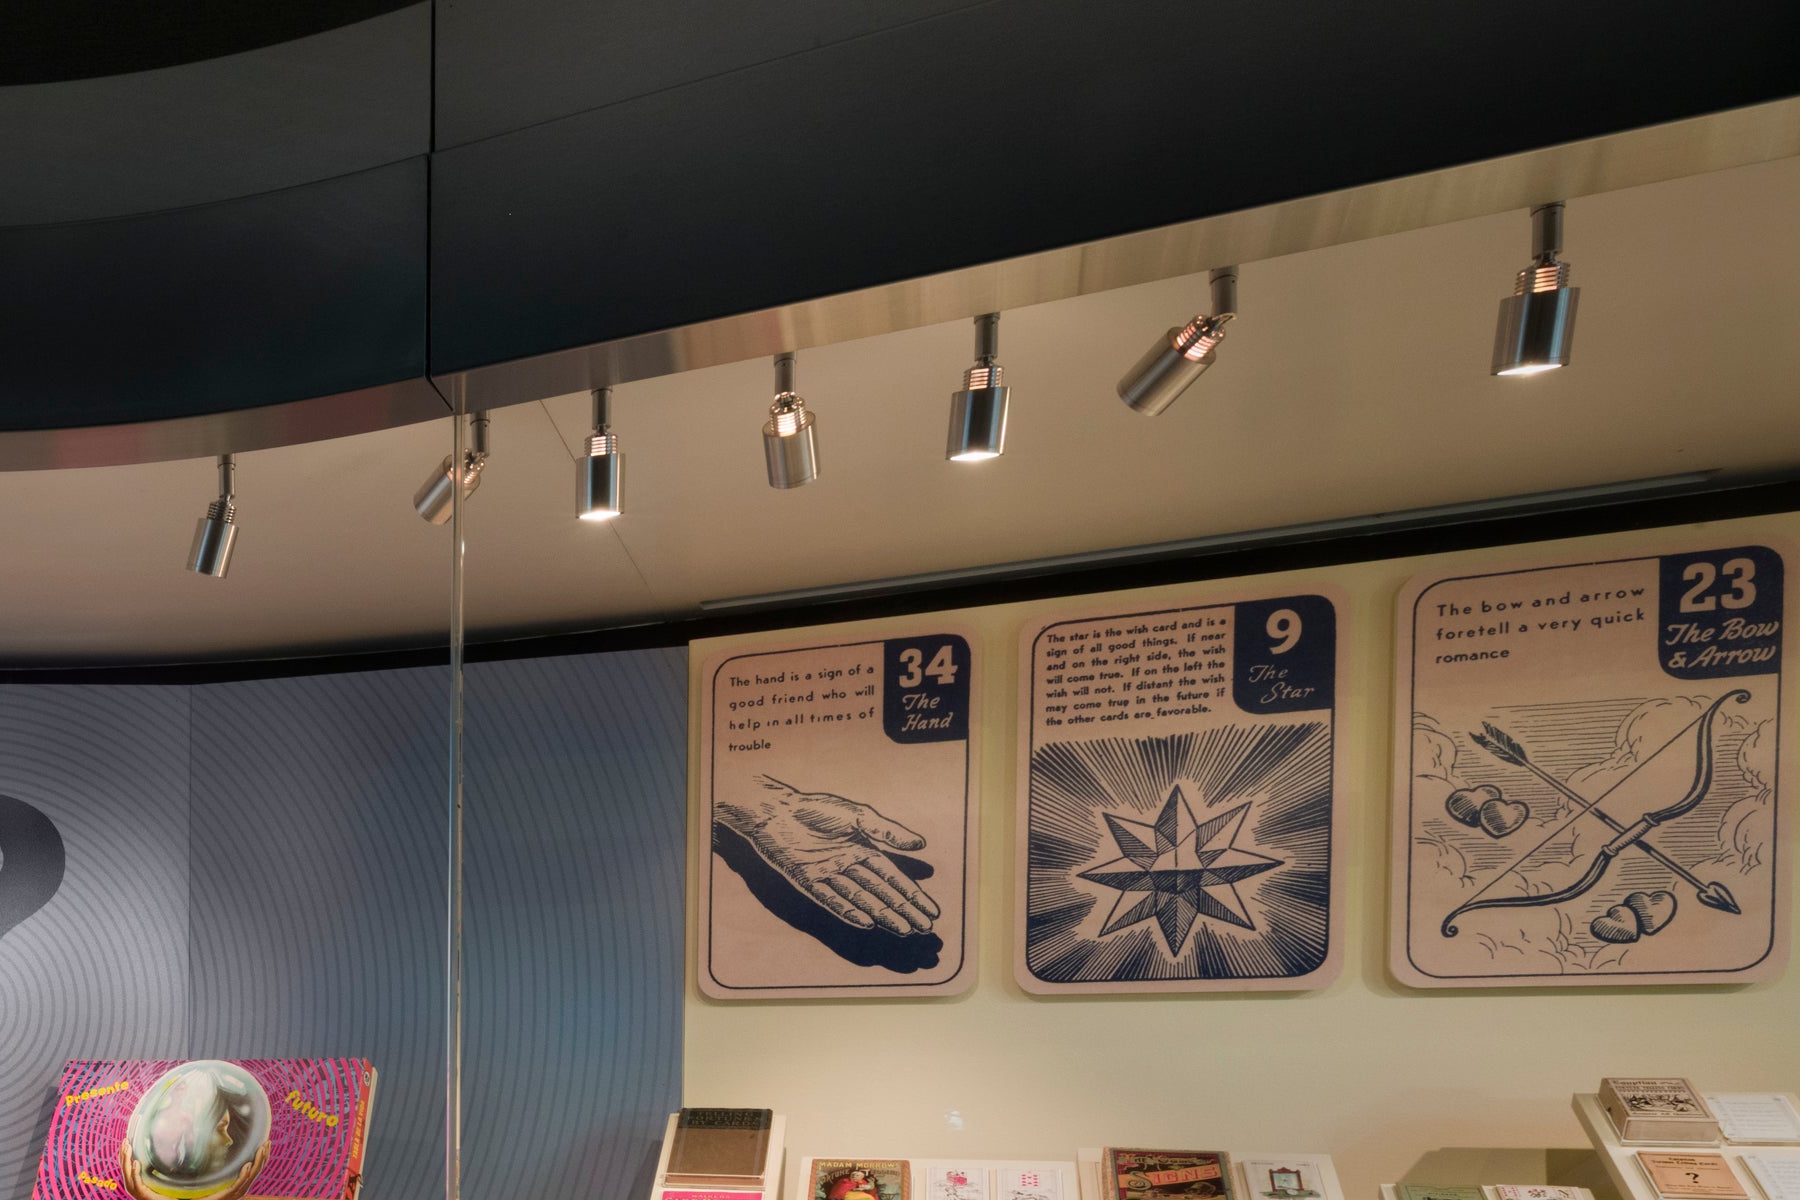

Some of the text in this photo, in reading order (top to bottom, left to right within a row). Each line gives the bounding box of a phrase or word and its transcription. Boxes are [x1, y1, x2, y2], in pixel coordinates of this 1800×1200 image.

[1679, 557, 1757, 614] 23
[1436, 587, 1644, 617] The bow and arrow
[1265, 608, 1303, 655] 9
[1435, 606, 1644, 641] foretell a very quick
[1665, 616, 1780, 646] The Bow
[899, 645, 959, 689] 34
[1434, 648, 1510, 664] romance
[1668, 645, 1777, 669] & Arrow
[1249, 663, 1288, 683] The
[902, 693, 940, 711] The
[1260, 681, 1315, 704] Star
[901, 711, 954, 732] Hand
